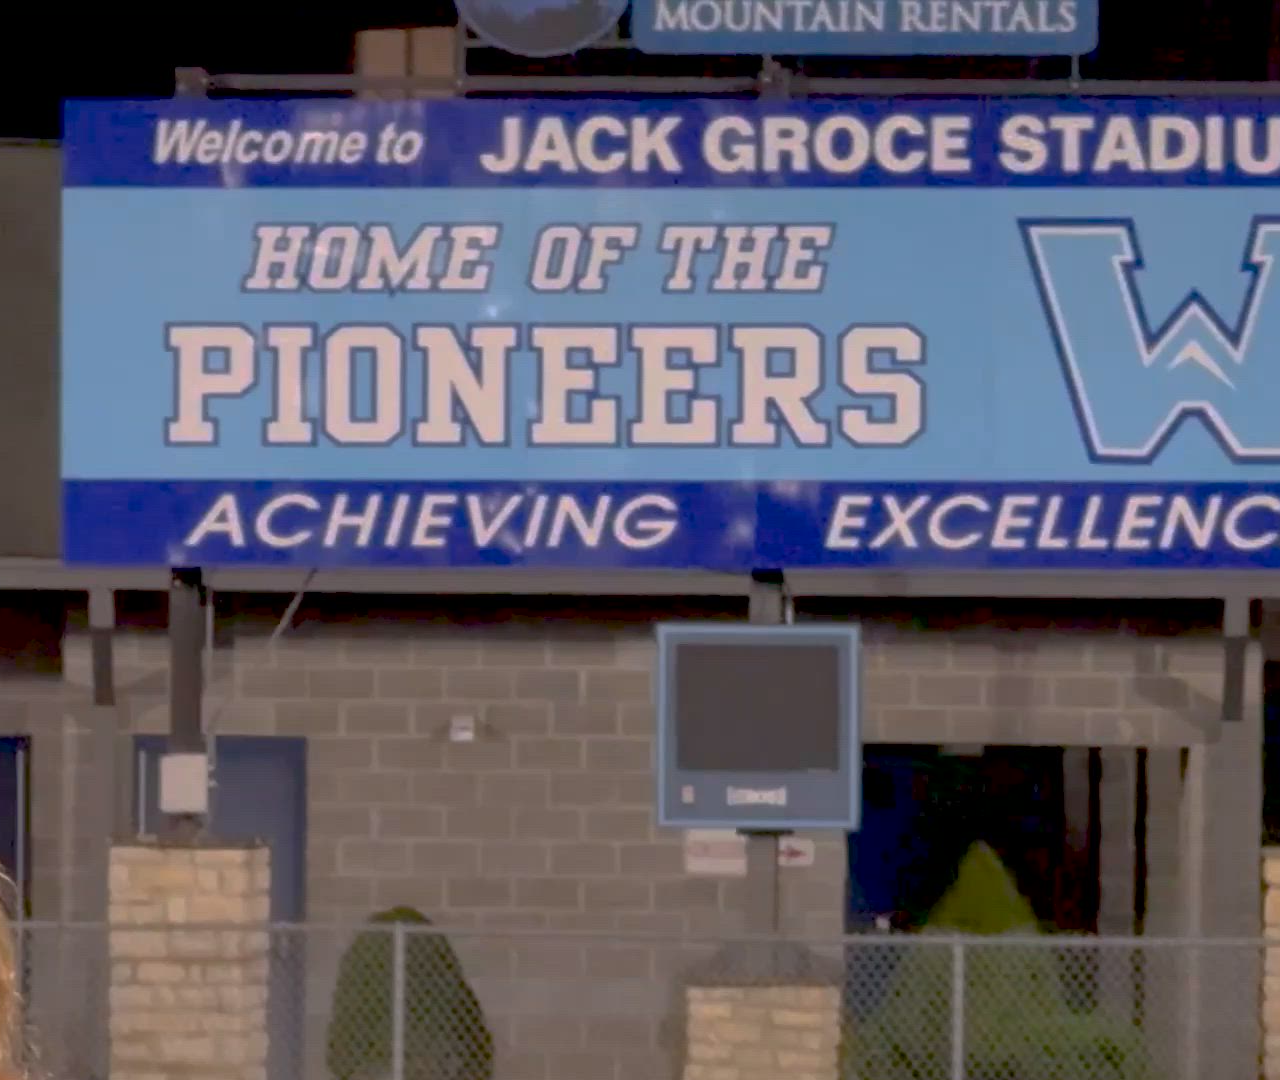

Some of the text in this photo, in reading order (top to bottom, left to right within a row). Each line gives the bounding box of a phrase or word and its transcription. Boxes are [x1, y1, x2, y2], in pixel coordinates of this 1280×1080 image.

[653, 0, 1078, 32] MOUNTAIN RENTALS
[152, 118, 367, 165] Welcome
[376, 121, 424, 164] to
[479, 116, 683, 173] JACK
[703, 116, 971, 173] GROCE
[241, 222, 836, 294] HOME OF THE
[164, 322, 927, 448] PIONEERS
[185, 493, 678, 549] ACHIEVING
